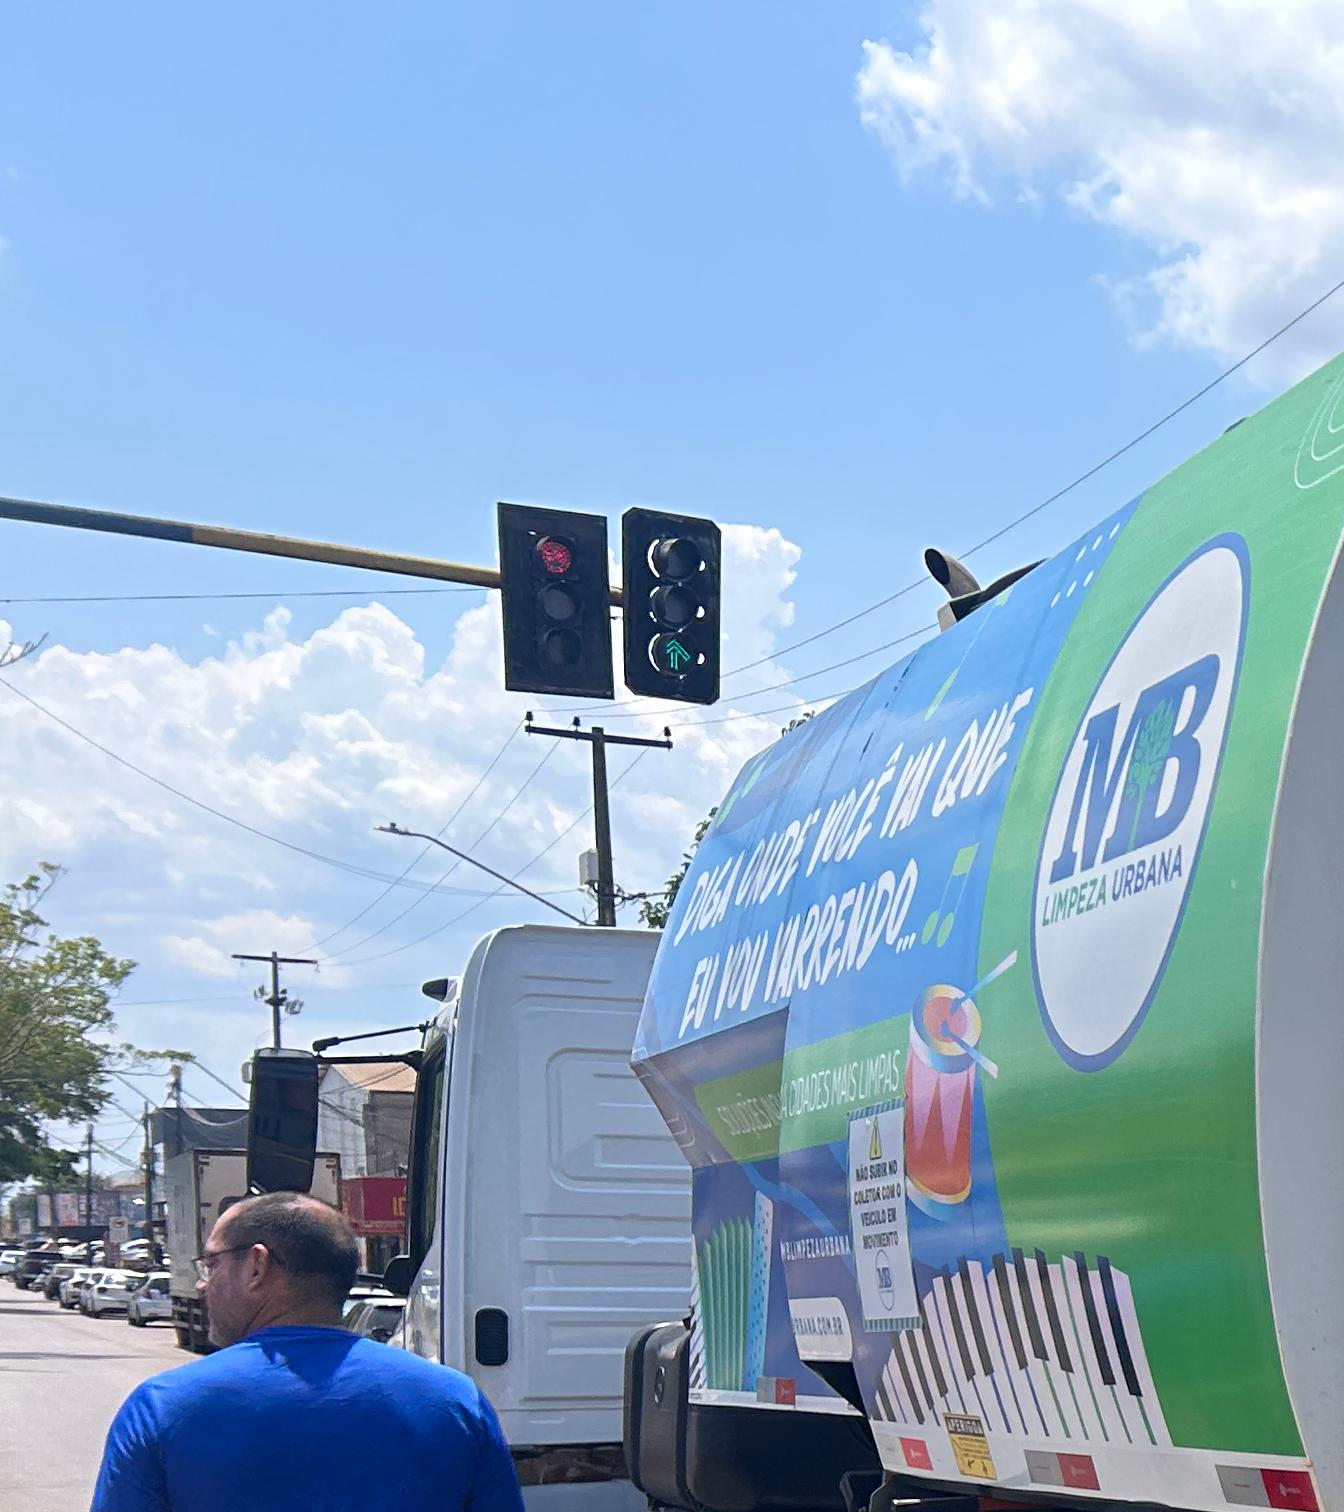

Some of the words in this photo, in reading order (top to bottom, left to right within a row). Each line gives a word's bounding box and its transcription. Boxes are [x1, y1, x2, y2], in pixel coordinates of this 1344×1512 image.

[1050, 654, 1220, 885] MB
[674, 850, 745, 946] DIGA
[735, 808, 820, 908] ONDE
[806, 742, 904, 878] VOCÊ
[880, 737, 946, 839] VAI
[931, 687, 1033, 817] QUE
[1042, 878, 1106, 927] LIMPEZA
[1111, 844, 1183, 901] URBANA
[714, 930, 769, 1021] VOU
[831, 1061, 859, 1107] MAIS
[858, 1049, 901, 1099] LIMPAS
[854, 1187, 881, 1206] COLETOR
[882, 1185, 895, 1201] COM
[856, 1163, 868, 1181] NÃO
[869, 1161, 887, 1180] SUBIR
[888, 1160, 898, 1176] NO
[886, 1207, 897, 1222] EM
